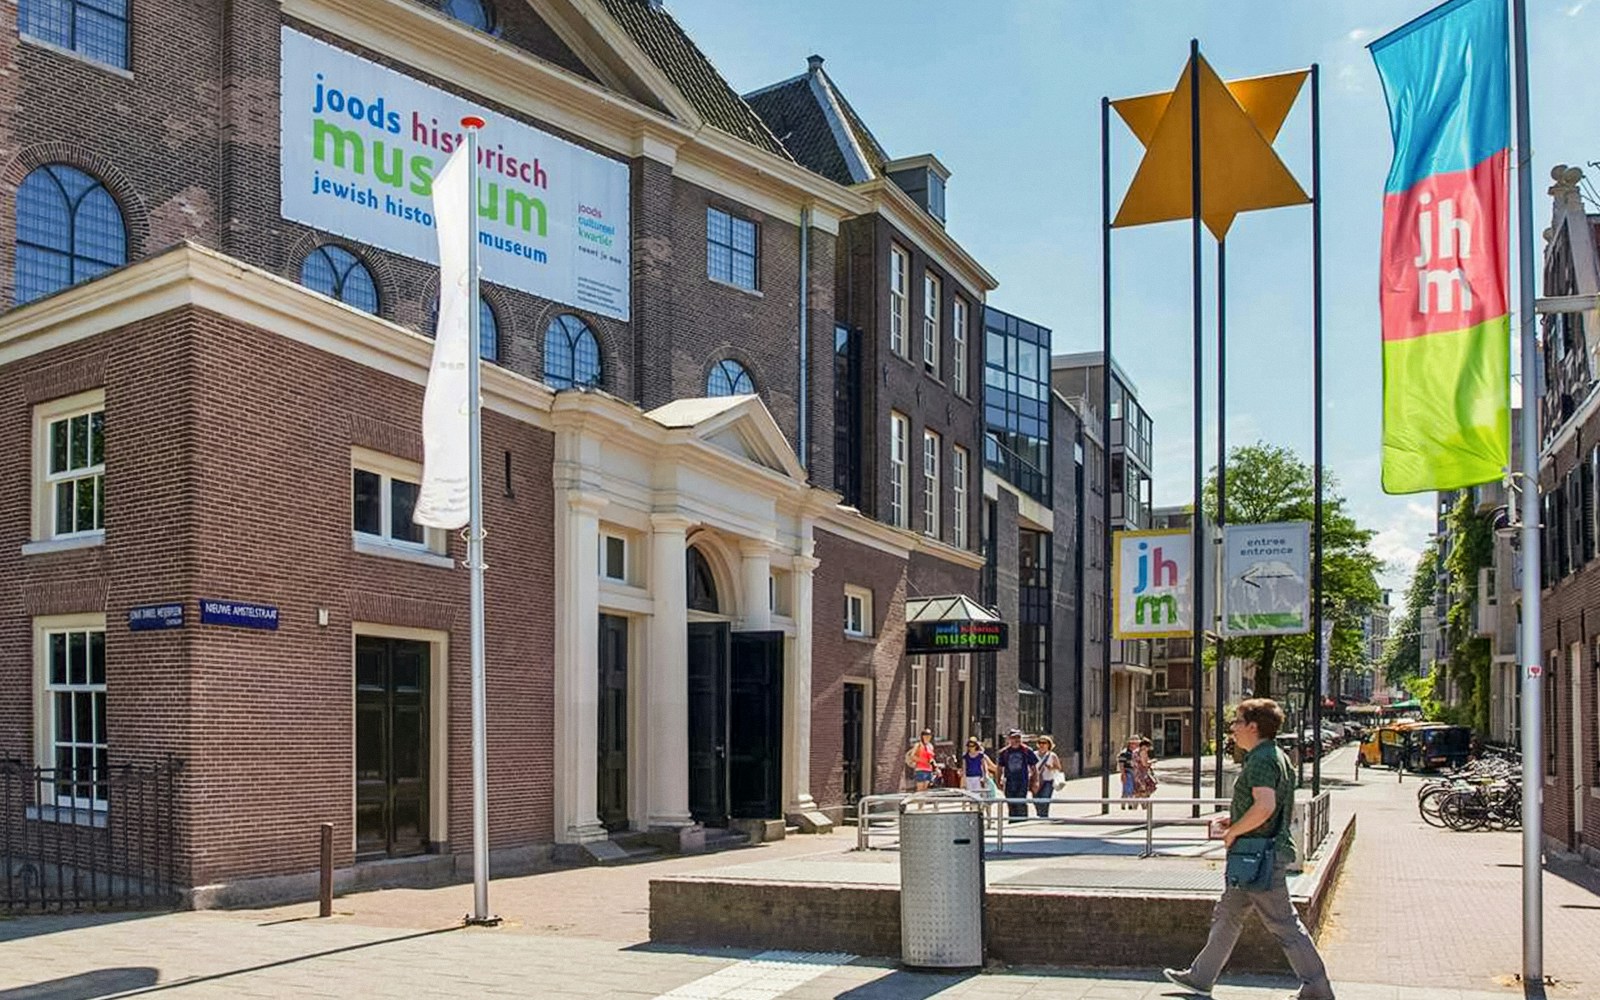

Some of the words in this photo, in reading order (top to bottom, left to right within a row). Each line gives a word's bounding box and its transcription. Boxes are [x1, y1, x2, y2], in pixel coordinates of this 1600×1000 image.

[313, 73, 401, 134] joods
[313, 118, 548, 237] musum
[312, 172, 379, 210] jewish
[479, 231, 548, 264] museum
[578, 203, 602, 218] joods
[1414, 192, 1472, 267] jh
[1418, 267, 1473, 314] m
[1132, 542, 1178, 594] jh
[1240, 547, 1294, 556] entrance
[205, 602, 231, 615] NIEUWE
[232, 605, 277, 619] AMSTELSTRAAT
[935, 633, 1000, 645] museum
